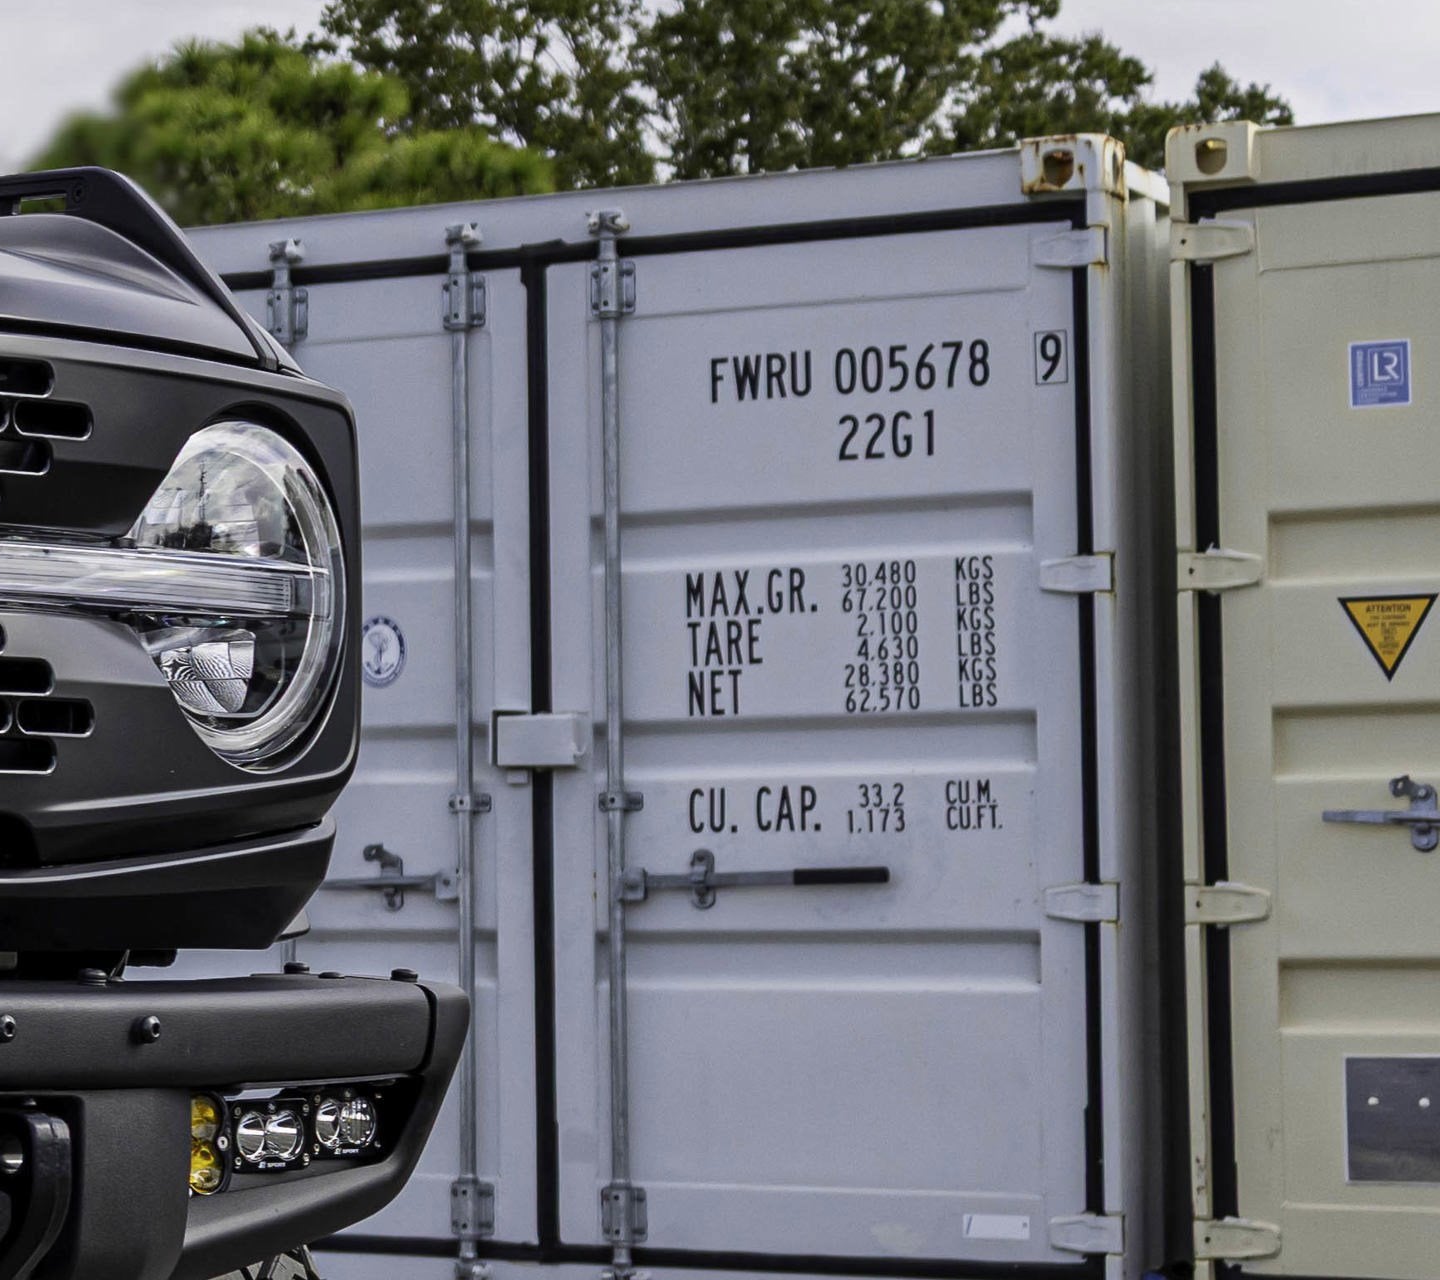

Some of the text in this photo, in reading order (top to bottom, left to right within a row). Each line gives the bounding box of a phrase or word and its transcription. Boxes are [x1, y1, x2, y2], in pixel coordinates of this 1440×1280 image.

[710, 332, 1062, 403] FWRU 005678 9
[838, 409, 935, 461] 22G1
[686, 567, 818, 618] MAX.GR.
[955, 555, 994, 581] KGS
[956, 580, 995, 607] LBS
[687, 618, 764, 667] TARE
[957, 606, 996, 632] KGS
[957, 631, 996, 657] LBS
[688, 669, 743, 717] NET
[958, 657, 997, 682] KGS
[959, 682, 998, 708] LBS
[689, 787, 739, 833] CU.
[755, 784, 822, 832] CAP.
